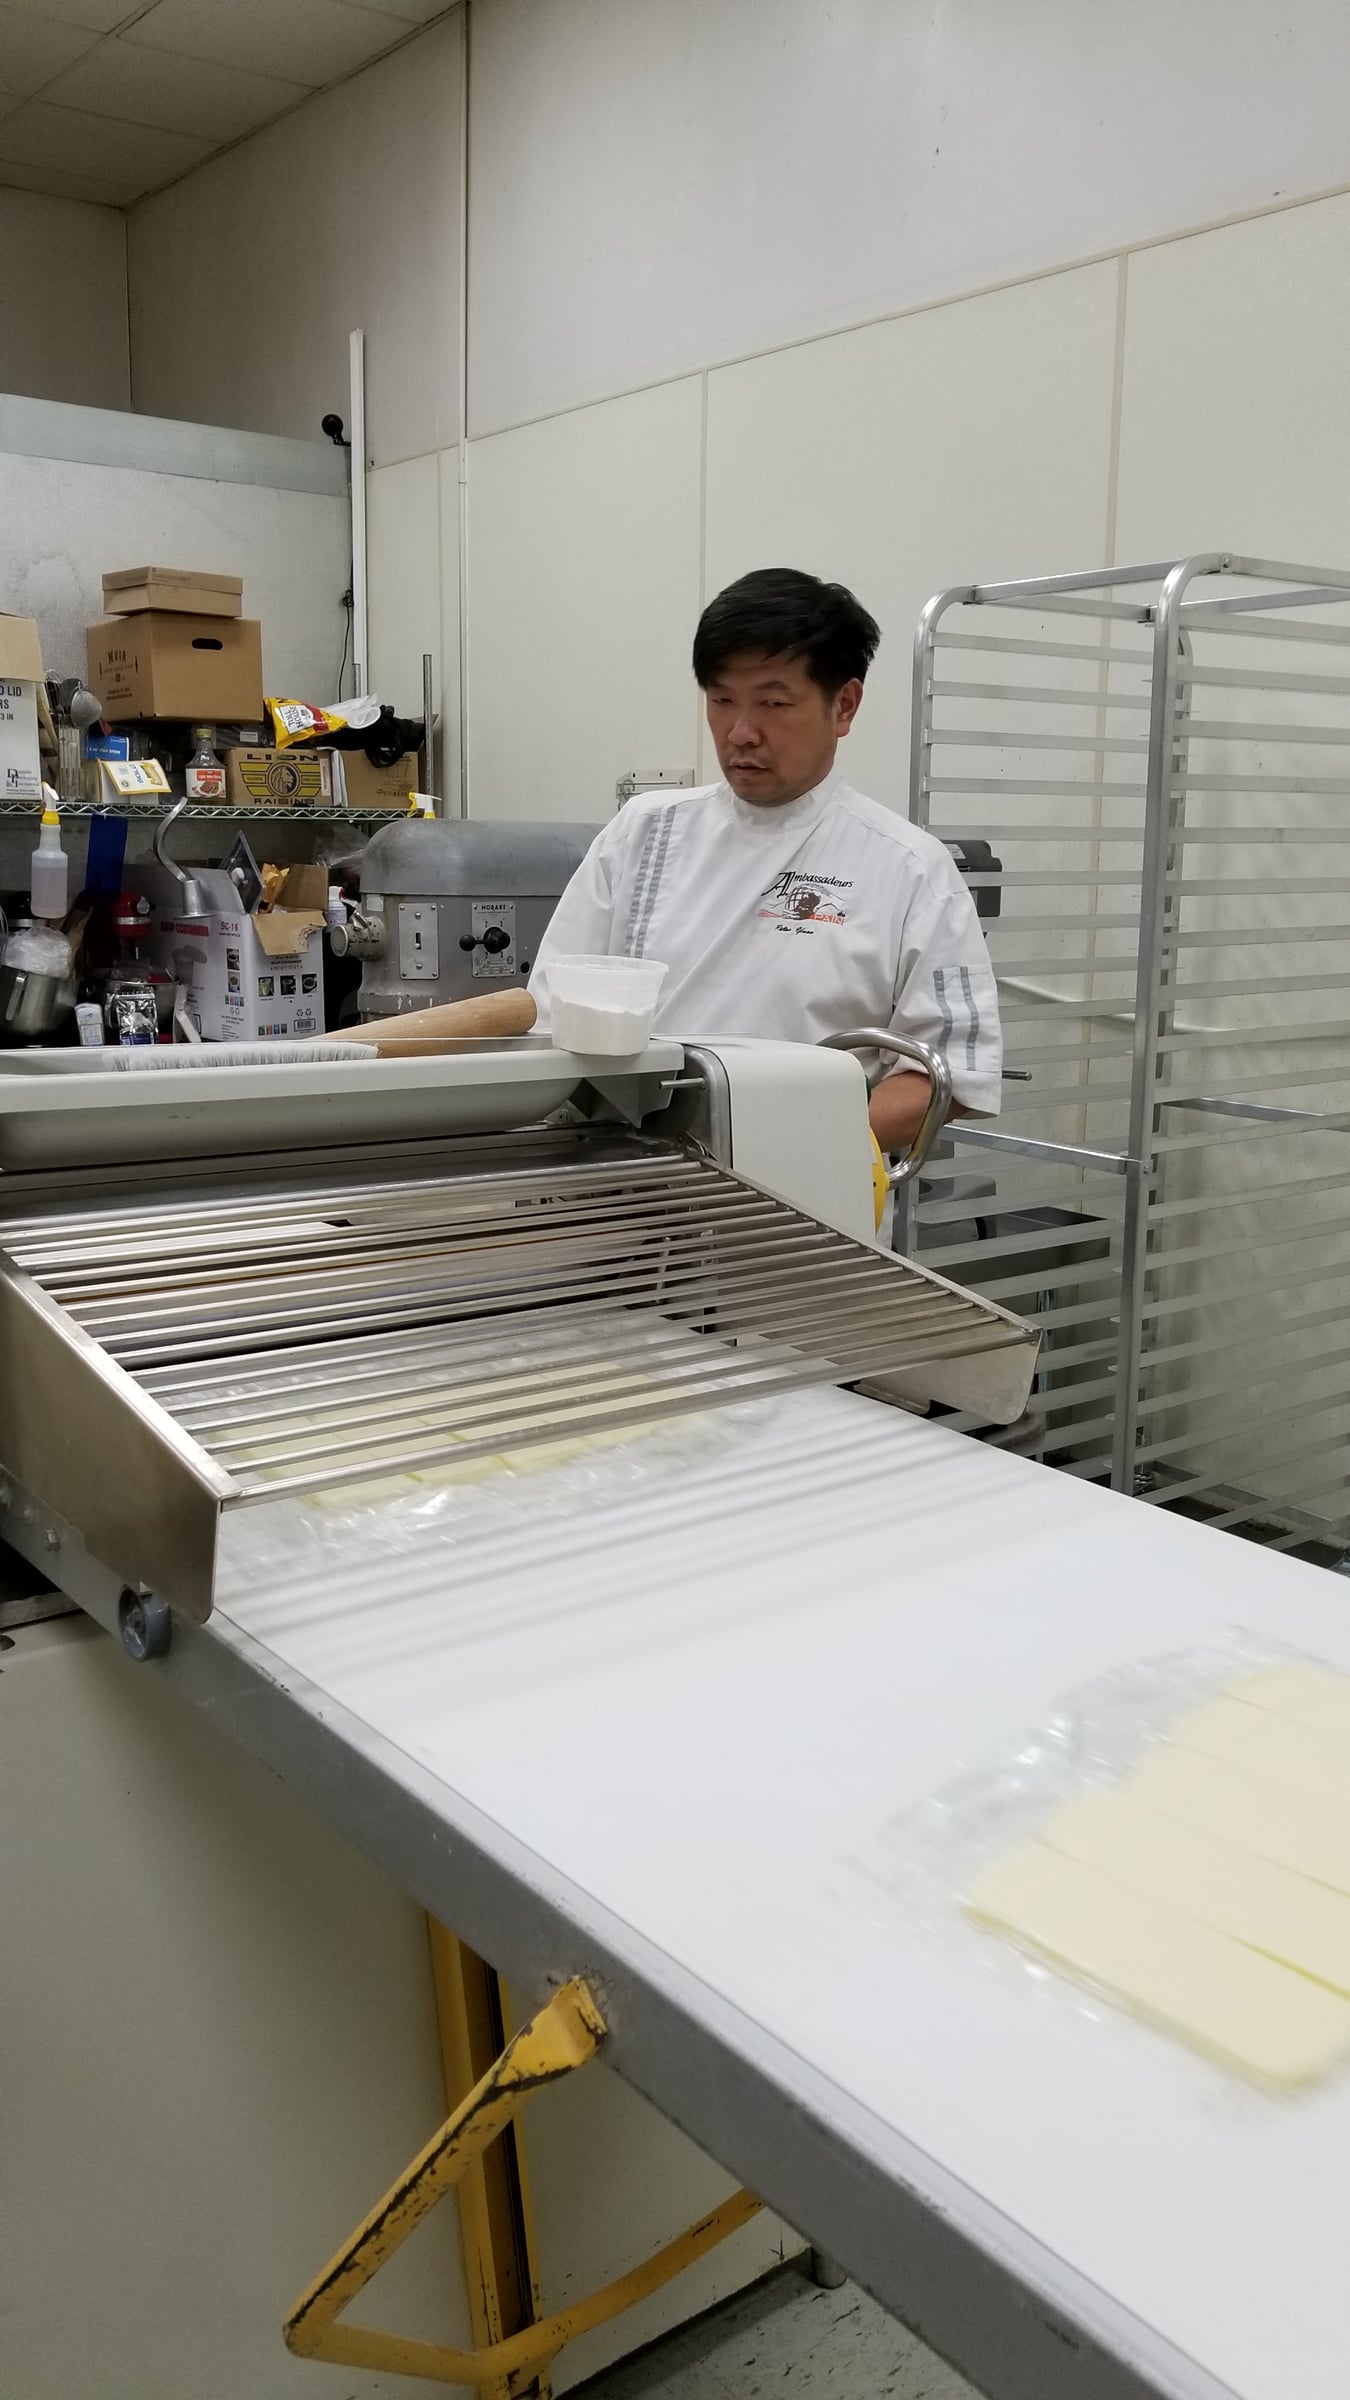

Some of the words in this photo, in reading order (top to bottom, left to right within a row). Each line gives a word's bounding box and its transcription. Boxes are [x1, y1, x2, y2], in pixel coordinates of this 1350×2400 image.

[8, 686, 22, 697] LID
[285, 711, 295, 727] TOLL
[289, 706, 304, 728] HOUSE
[247, 753, 318, 761] LION
[761, 871, 853, 898] Ambassadeurs
[814, 914, 845, 925] PAIN
